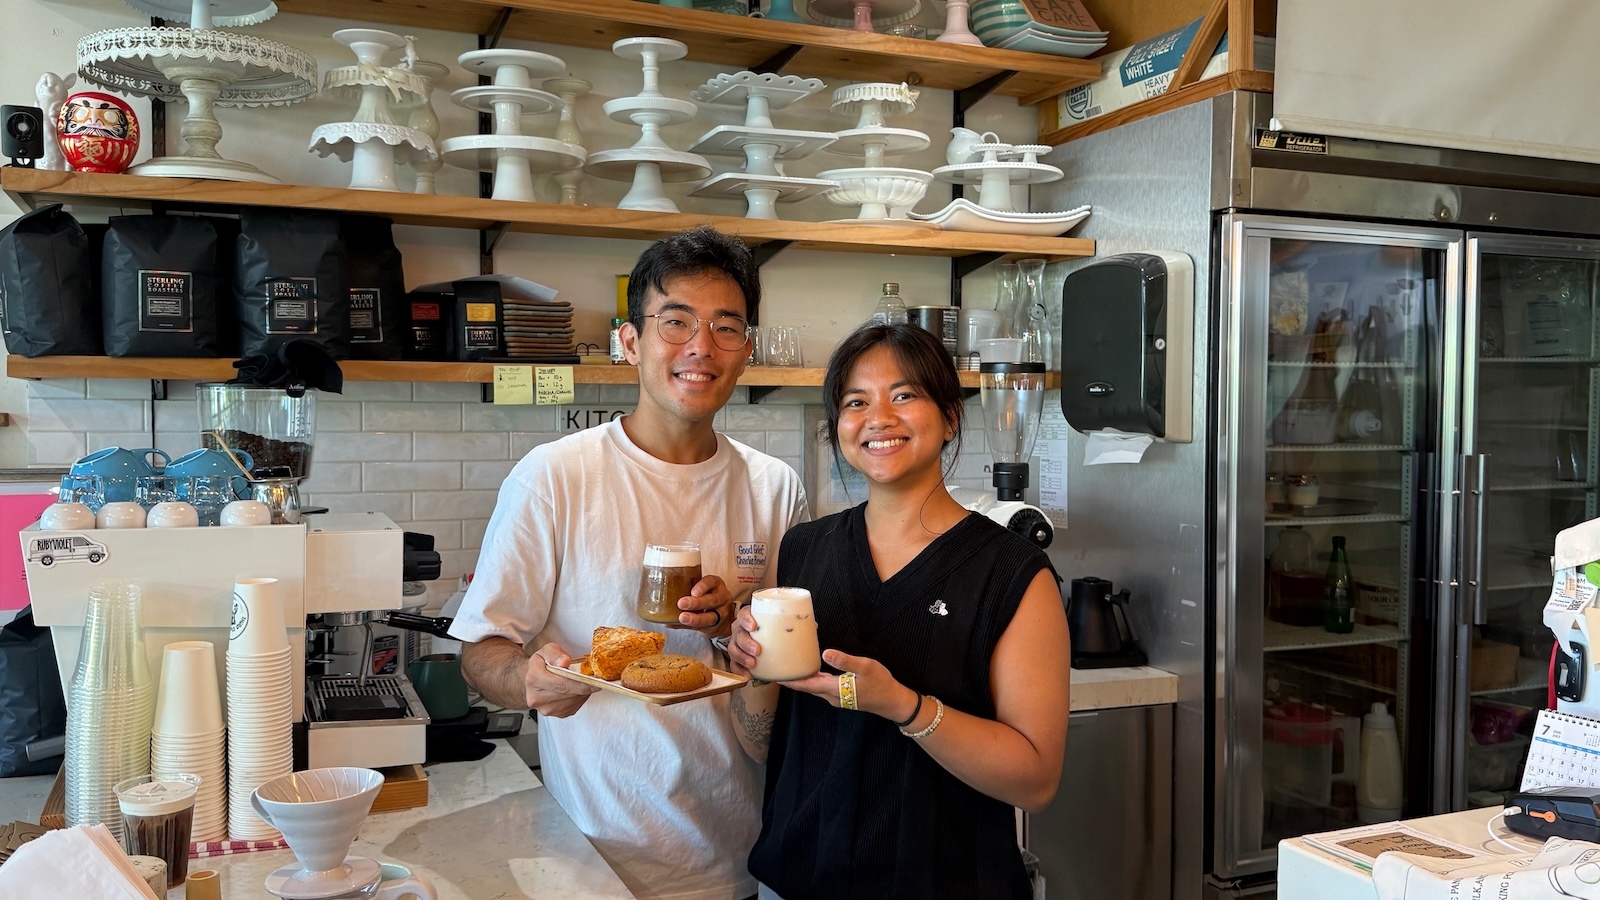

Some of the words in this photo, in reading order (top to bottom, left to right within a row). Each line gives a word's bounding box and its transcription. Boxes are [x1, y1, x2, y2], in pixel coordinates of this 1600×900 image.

[1030, 0, 1076, 15] EAT
[1037, 10, 1092, 28] CAKE
[1147, 38, 1179, 59] SHEET
[1125, 60, 1154, 81] WHITE
[1144, 73, 1170, 90] HEAVY
[147, 276, 184, 285] STERLING
[274, 282, 309, 290] STERLG
[567, 409, 635, 429] KITC
[739, 545, 753, 555] Good
[737, 555, 754, 565] Charlie
[1542, 724, 1551, 735] 7
